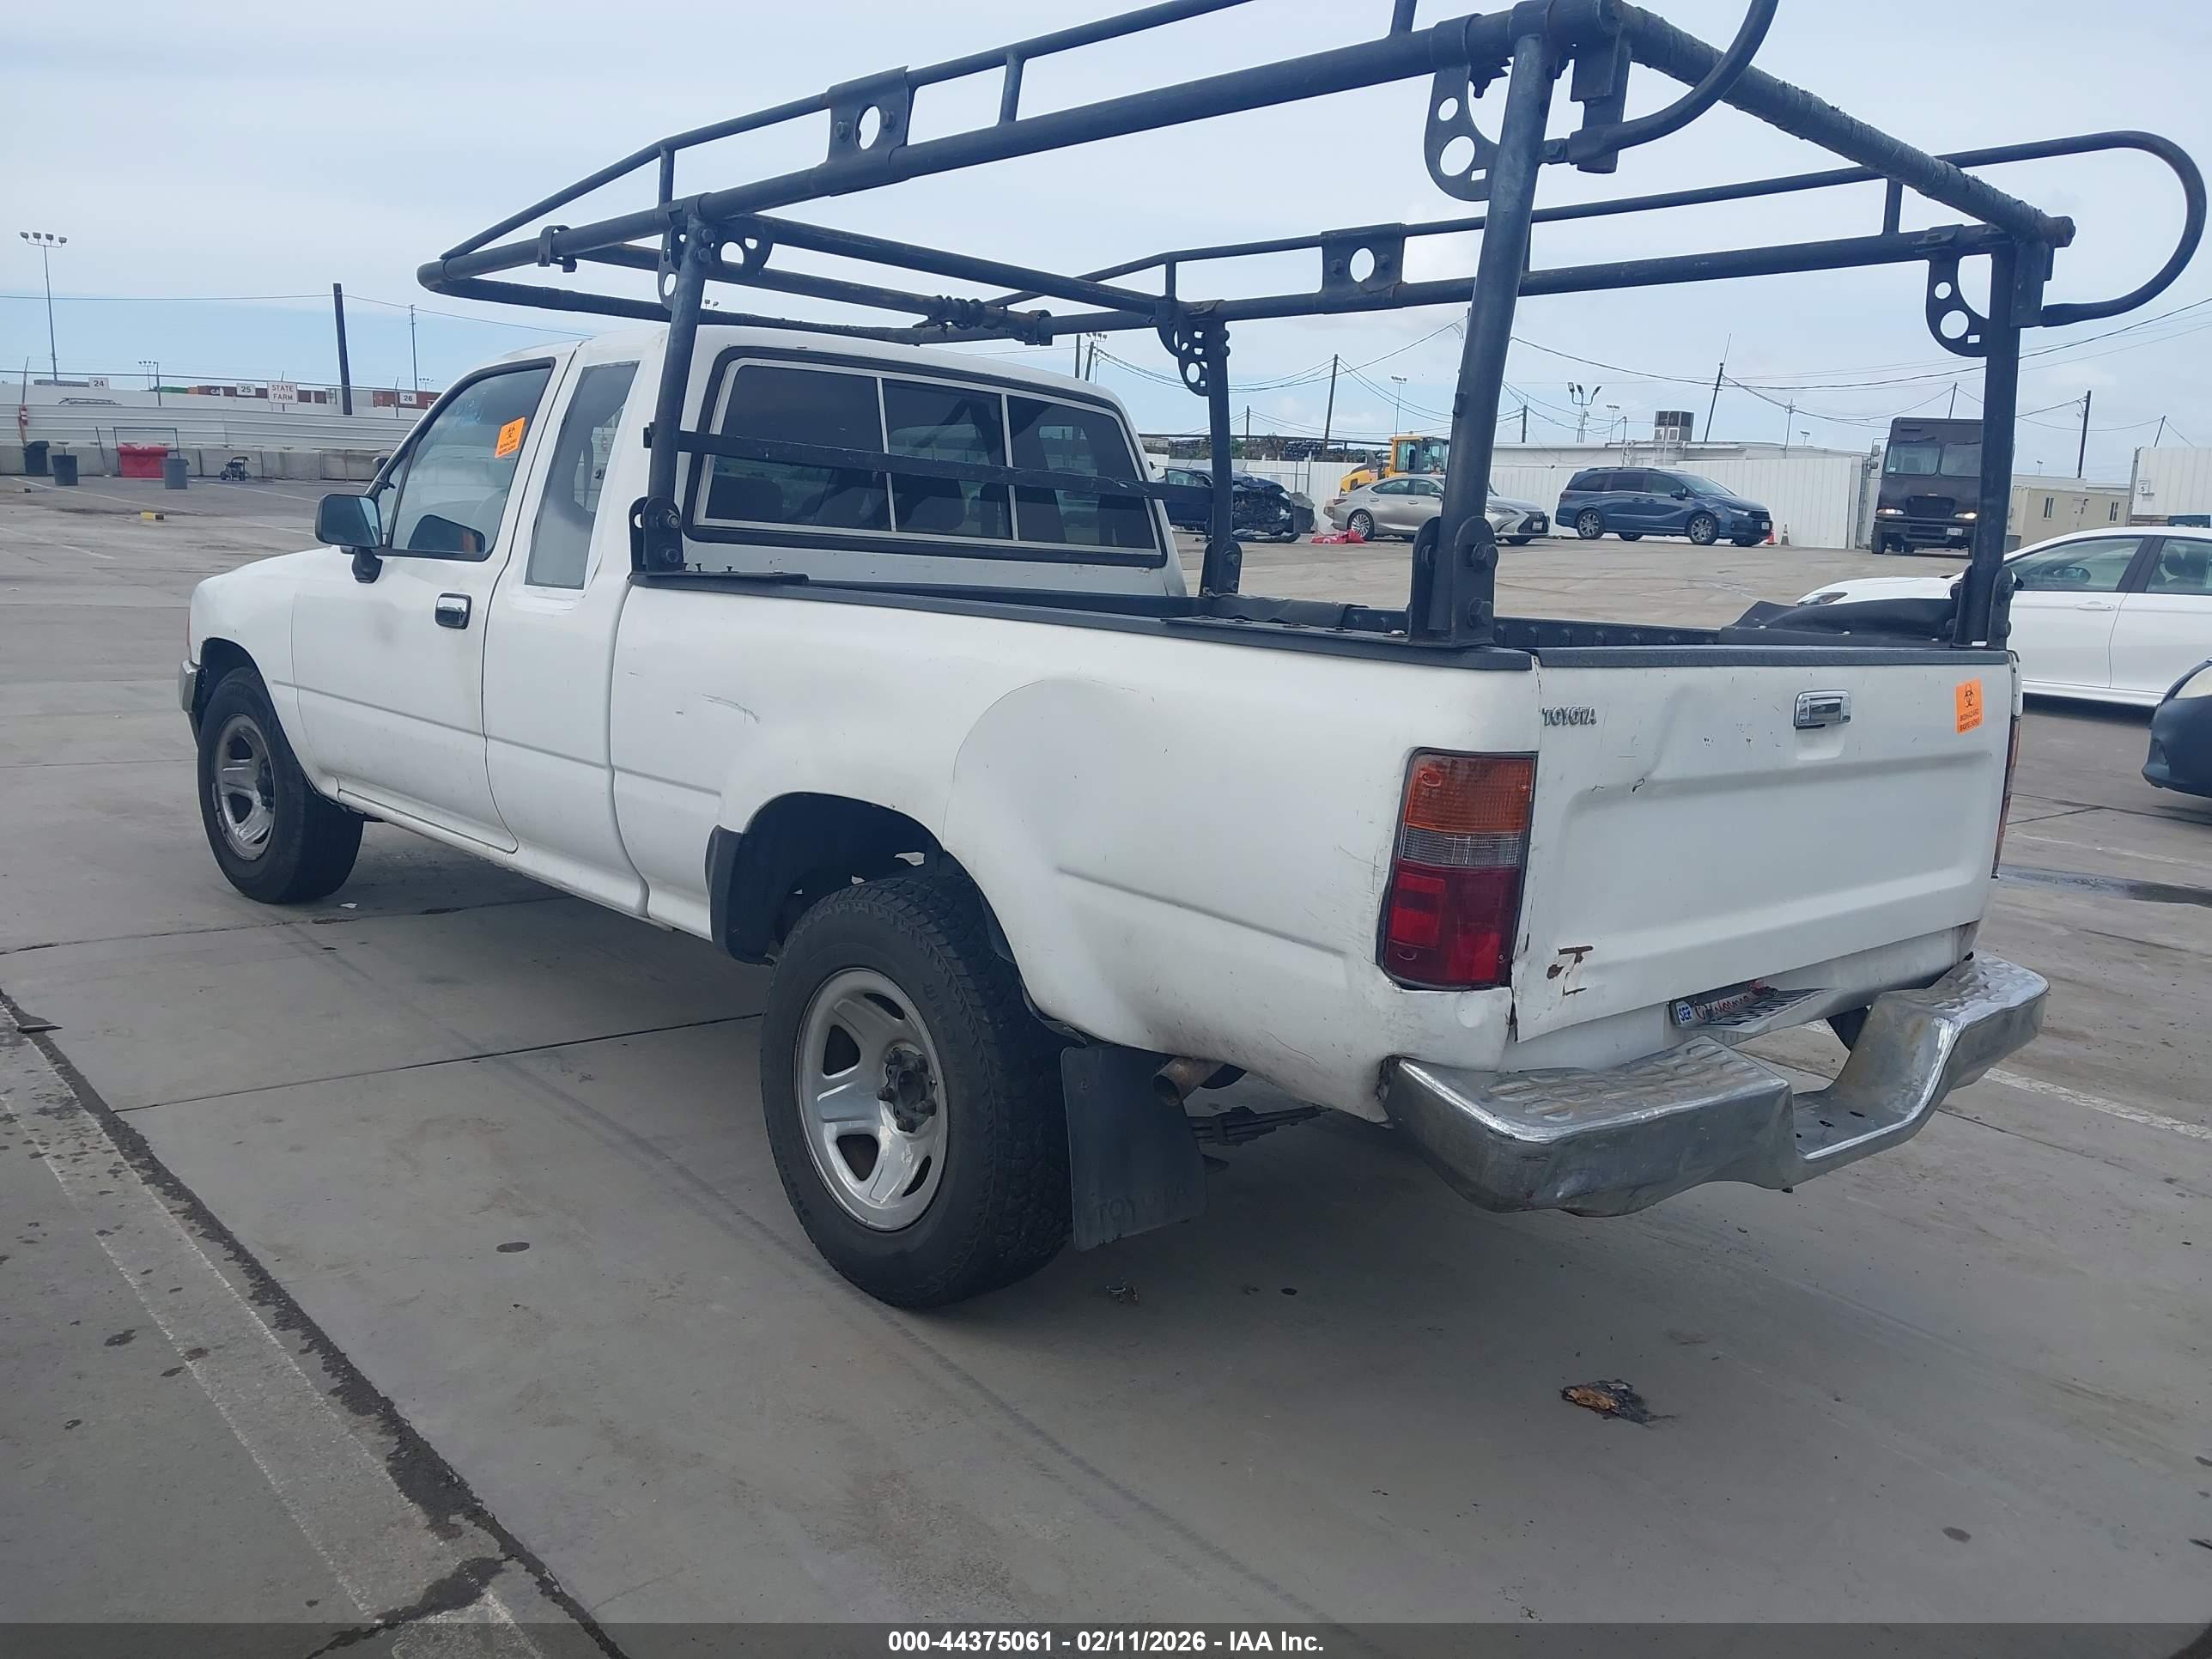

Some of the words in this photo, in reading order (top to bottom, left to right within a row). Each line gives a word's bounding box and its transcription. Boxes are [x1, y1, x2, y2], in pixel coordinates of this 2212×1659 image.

[271, 384, 294, 392] STATE
[1542, 707, 1597, 726] TOYOTA
[1678, 1004, 1692, 1022] SEP
